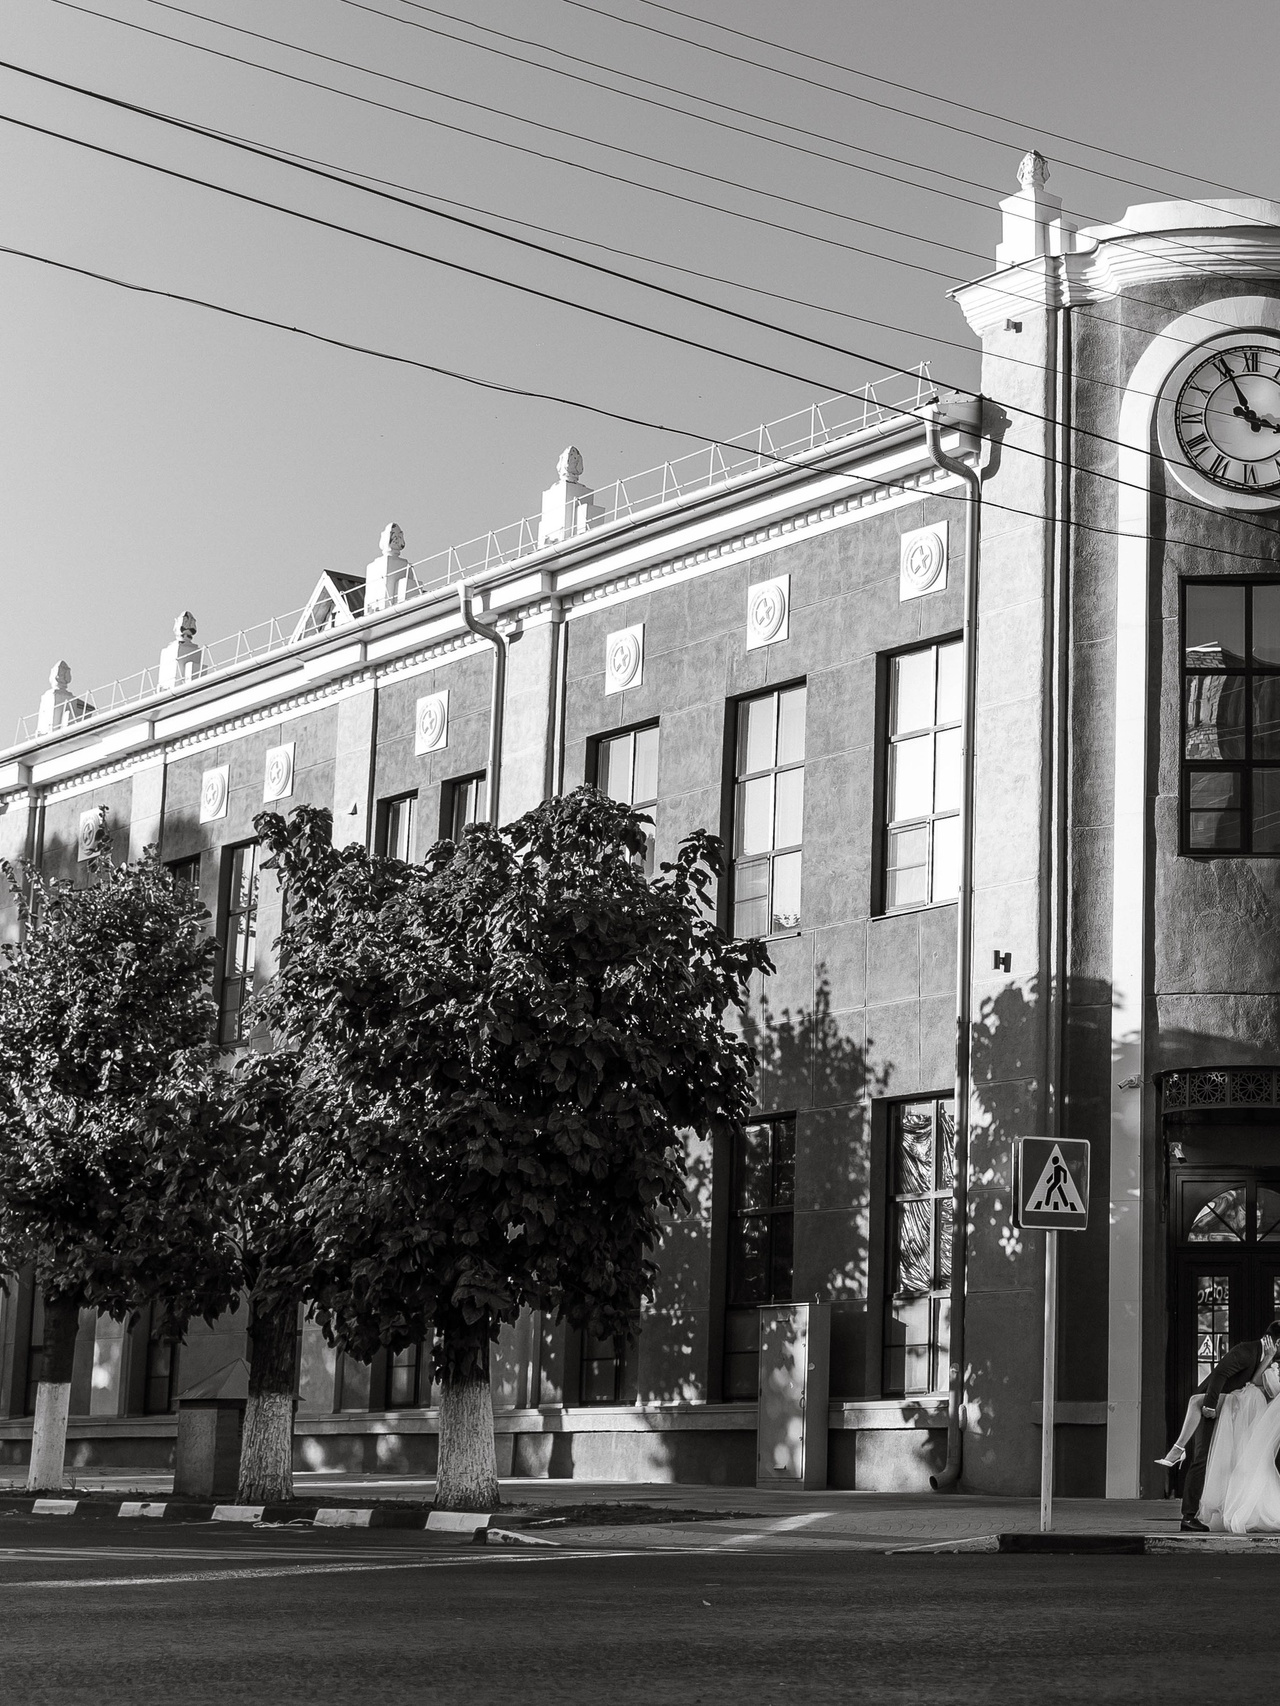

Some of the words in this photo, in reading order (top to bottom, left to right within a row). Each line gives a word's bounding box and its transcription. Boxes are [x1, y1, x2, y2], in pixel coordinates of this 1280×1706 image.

[1241, 352, 1260, 372] XII
[1189, 380, 1211, 399] X
[1181, 411, 1203, 424] IX
[1186, 431, 1212, 459] VIII
[1209, 453, 1231, 478] VII
